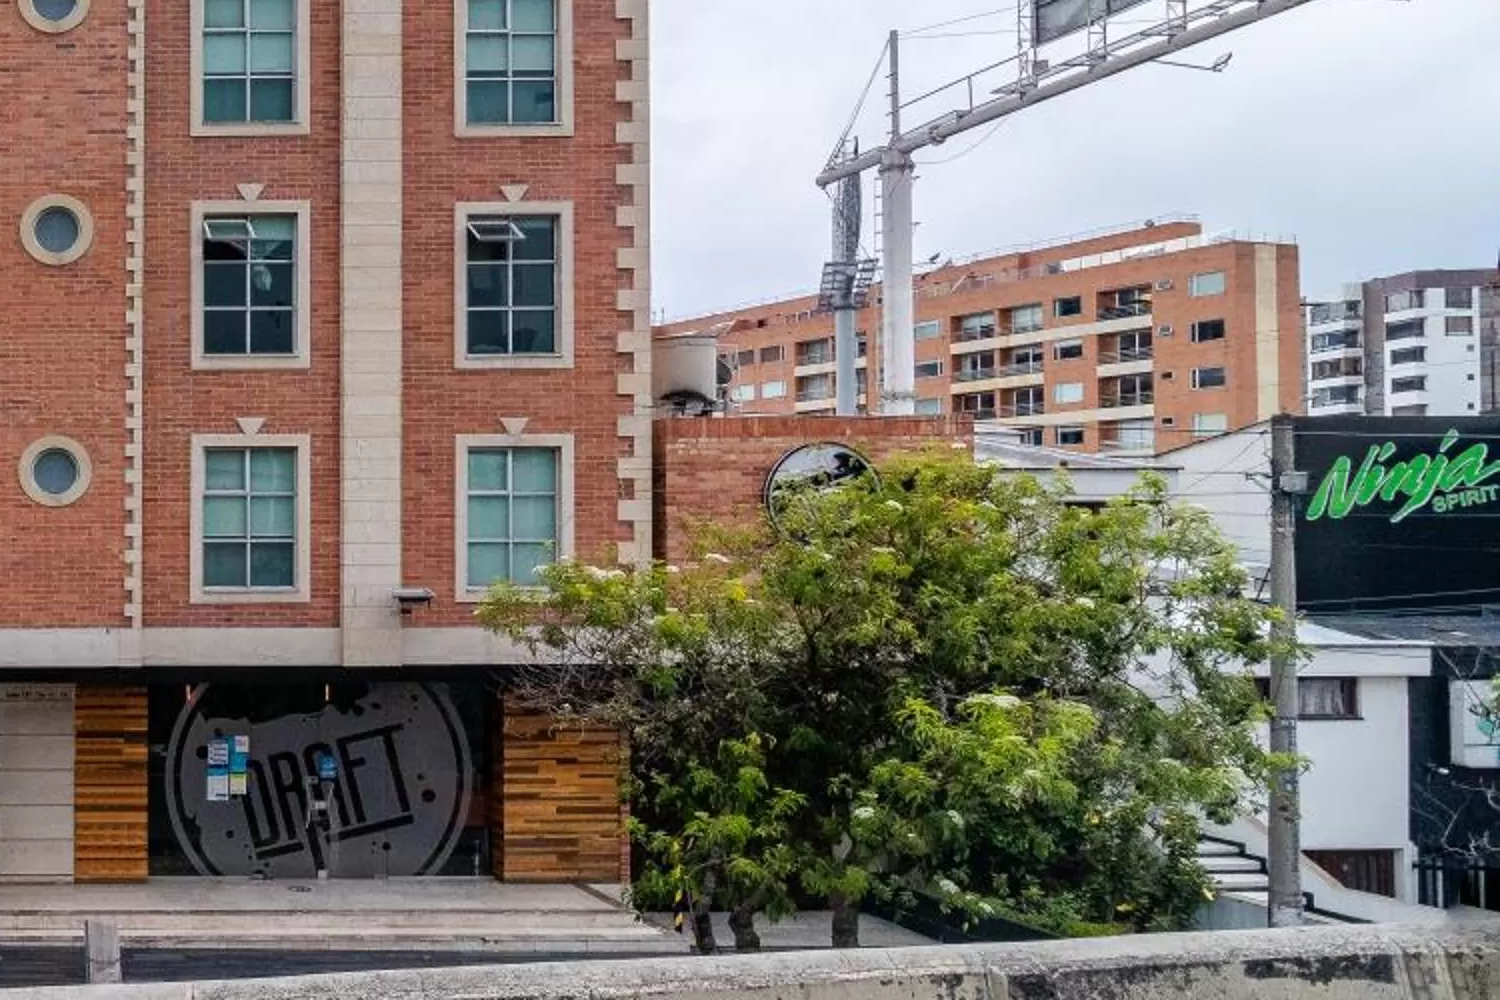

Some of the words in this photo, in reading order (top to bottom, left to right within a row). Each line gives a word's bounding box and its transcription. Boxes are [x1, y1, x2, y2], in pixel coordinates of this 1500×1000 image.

[1305, 428, 1500, 523] Ninja
[1431, 485, 1500, 512] SPIRIT
[240, 725, 411, 860] DRAFT
